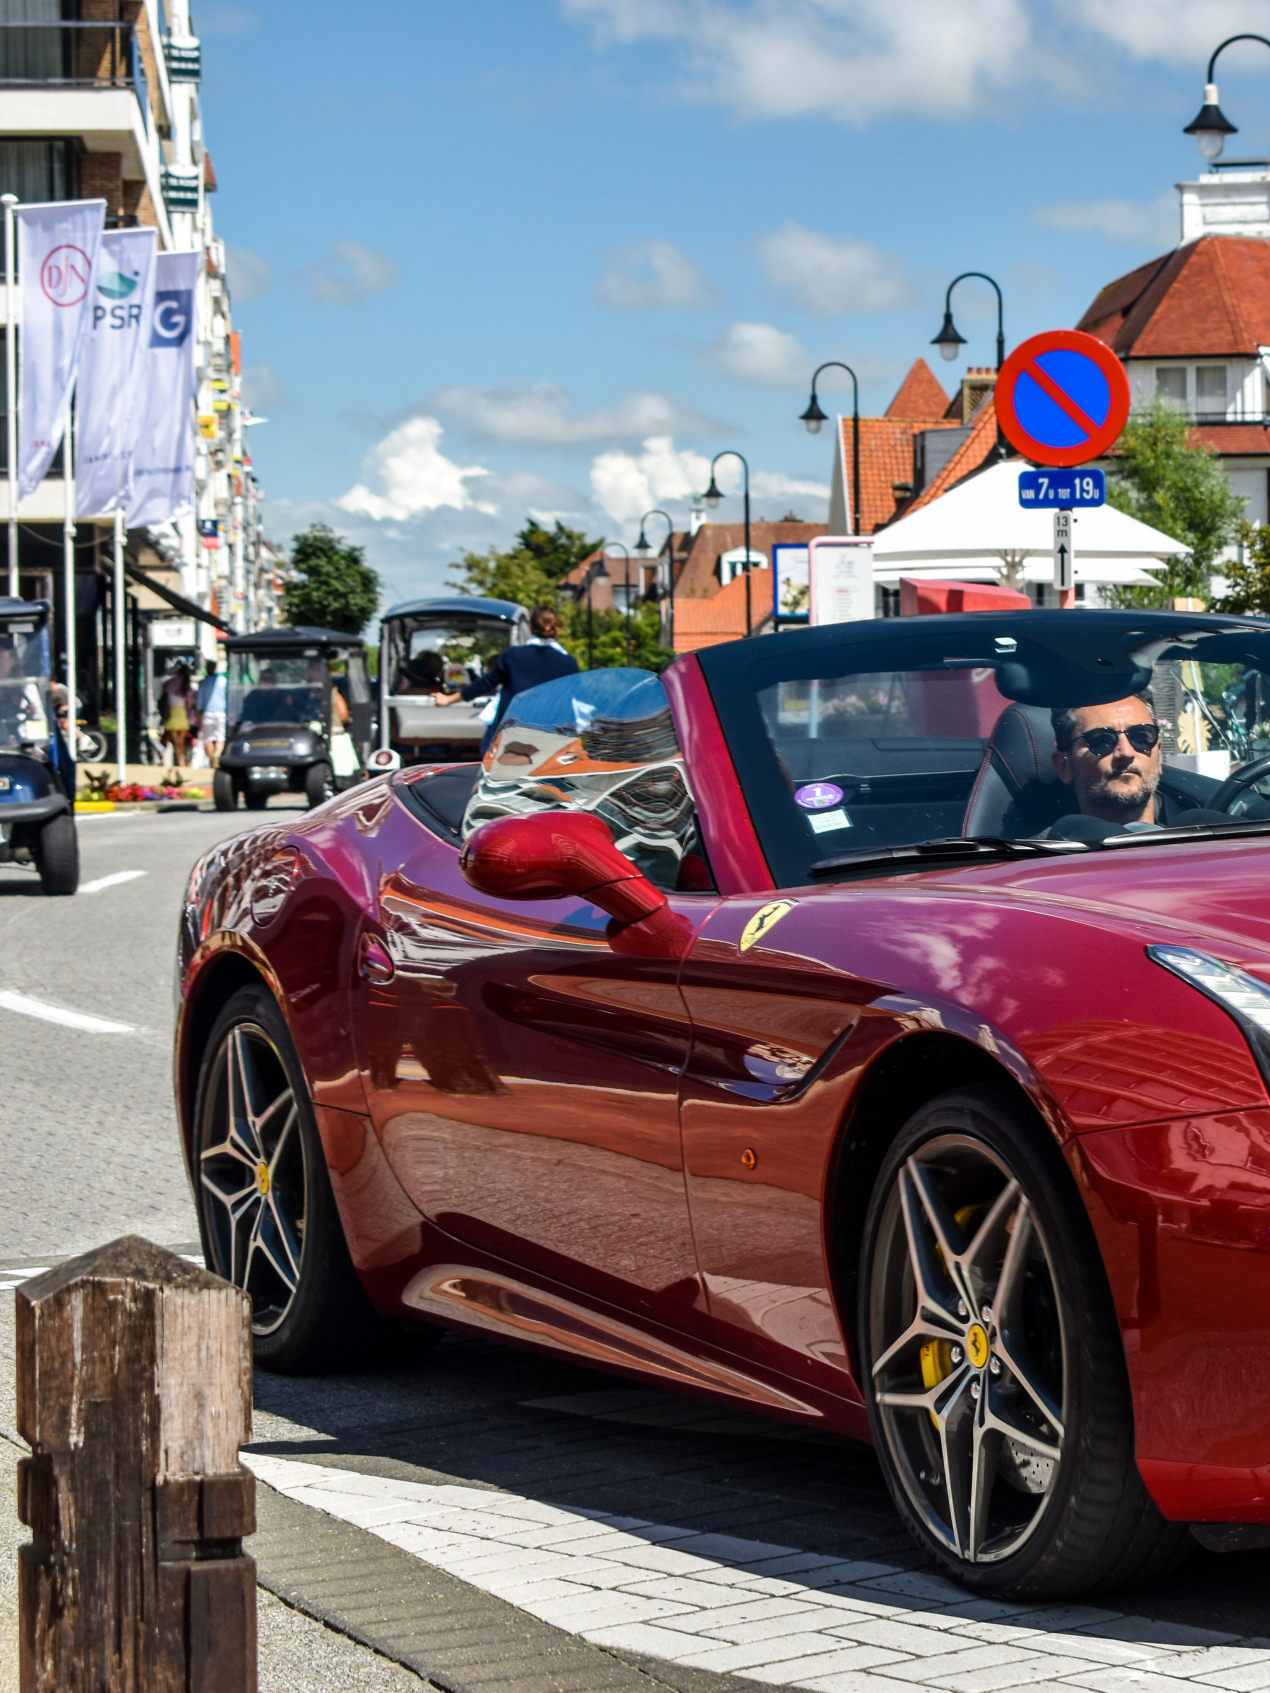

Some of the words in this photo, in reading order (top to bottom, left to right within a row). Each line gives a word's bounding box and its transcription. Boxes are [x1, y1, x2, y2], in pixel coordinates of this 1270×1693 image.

[92, 304, 142, 331] PSR
[154, 300, 187, 339] G
[1021, 488, 1035, 500] VAN
[1057, 488, 1071, 499] TOT
[1056, 515, 1069, 527] 13
[1056, 528, 1068, 538] m
